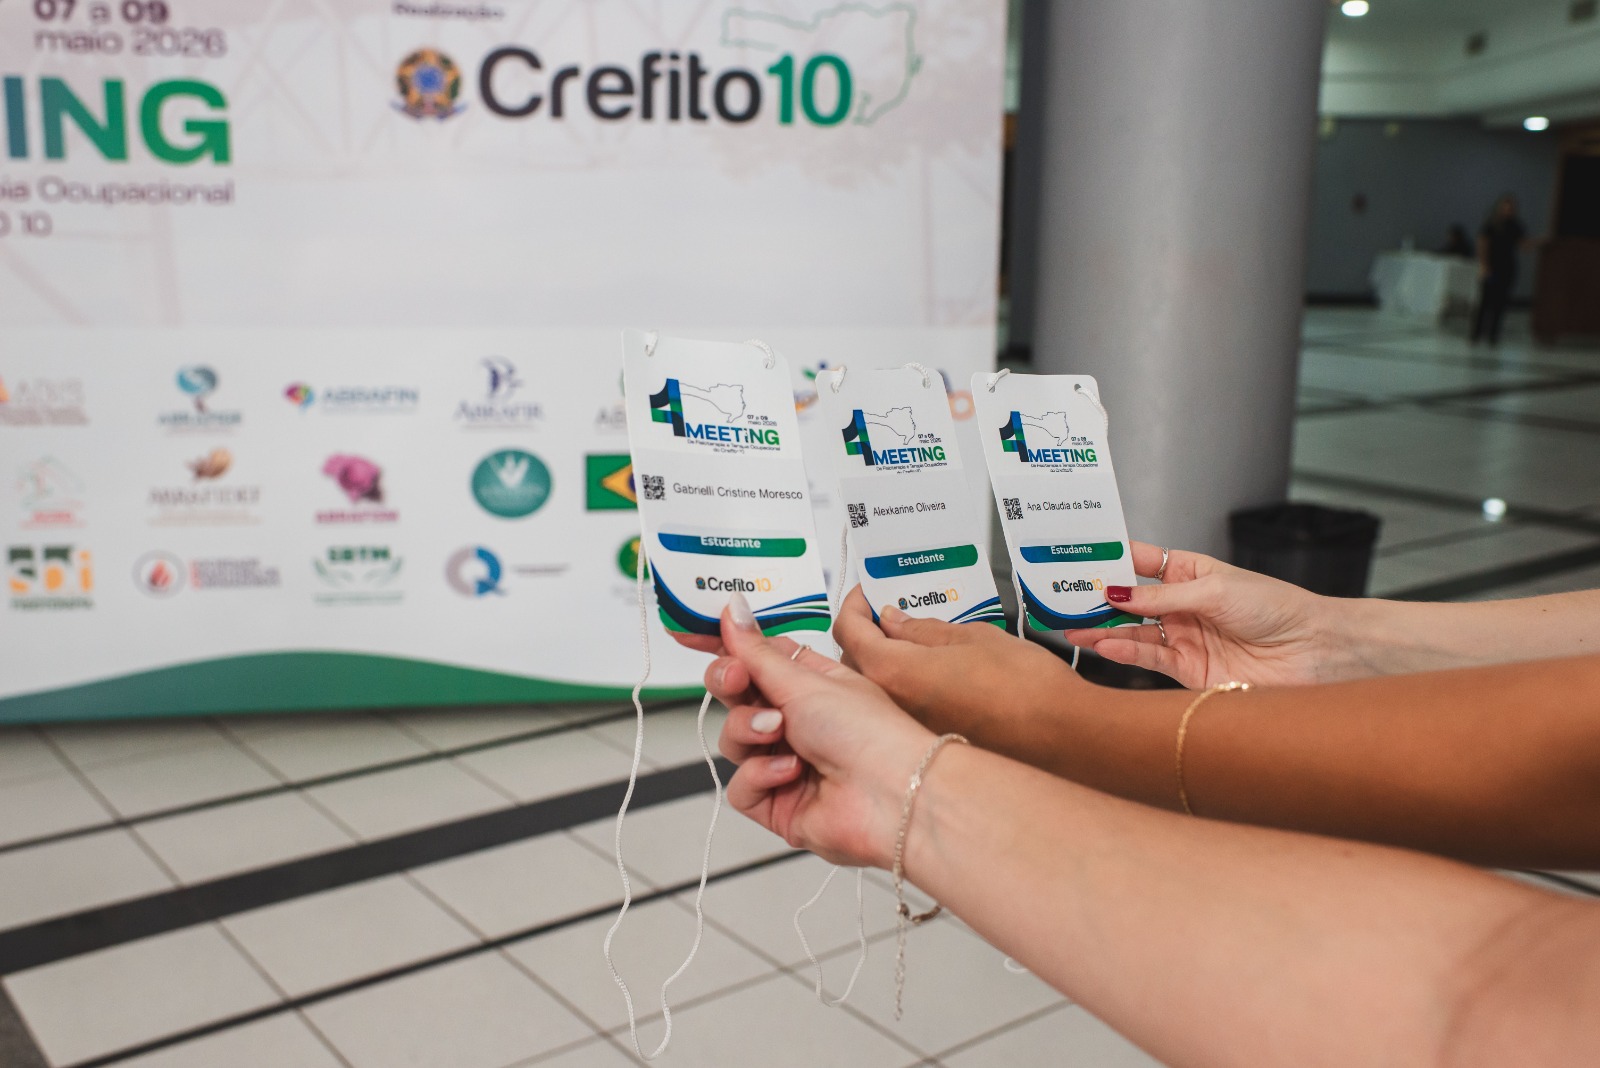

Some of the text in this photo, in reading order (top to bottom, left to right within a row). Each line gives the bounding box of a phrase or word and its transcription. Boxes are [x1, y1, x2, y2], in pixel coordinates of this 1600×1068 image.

[33, 0, 170, 25] 07 a 09
[34, 28, 228, 58] maio 2026
[478, 45, 853, 126] Crefito10
[37, 176, 235, 206] Ocupacional
[873, 445, 946, 465] MEETING
[1027, 448, 1097, 462] MEETING
[672, 482, 715, 498] Gabrielli
[717, 486, 756, 499] Cristine
[759, 488, 803, 500] Moresco
[873, 501, 946, 517] Alexkarine Oliveira
[1027, 500, 1102, 511] Ana Claudia da Silva
[701, 536, 761, 549] Estudante
[1050, 545, 1093, 555] Estudante
[897, 553, 945, 567] Estudante
[1061, 579, 1103, 592] Crefito10
